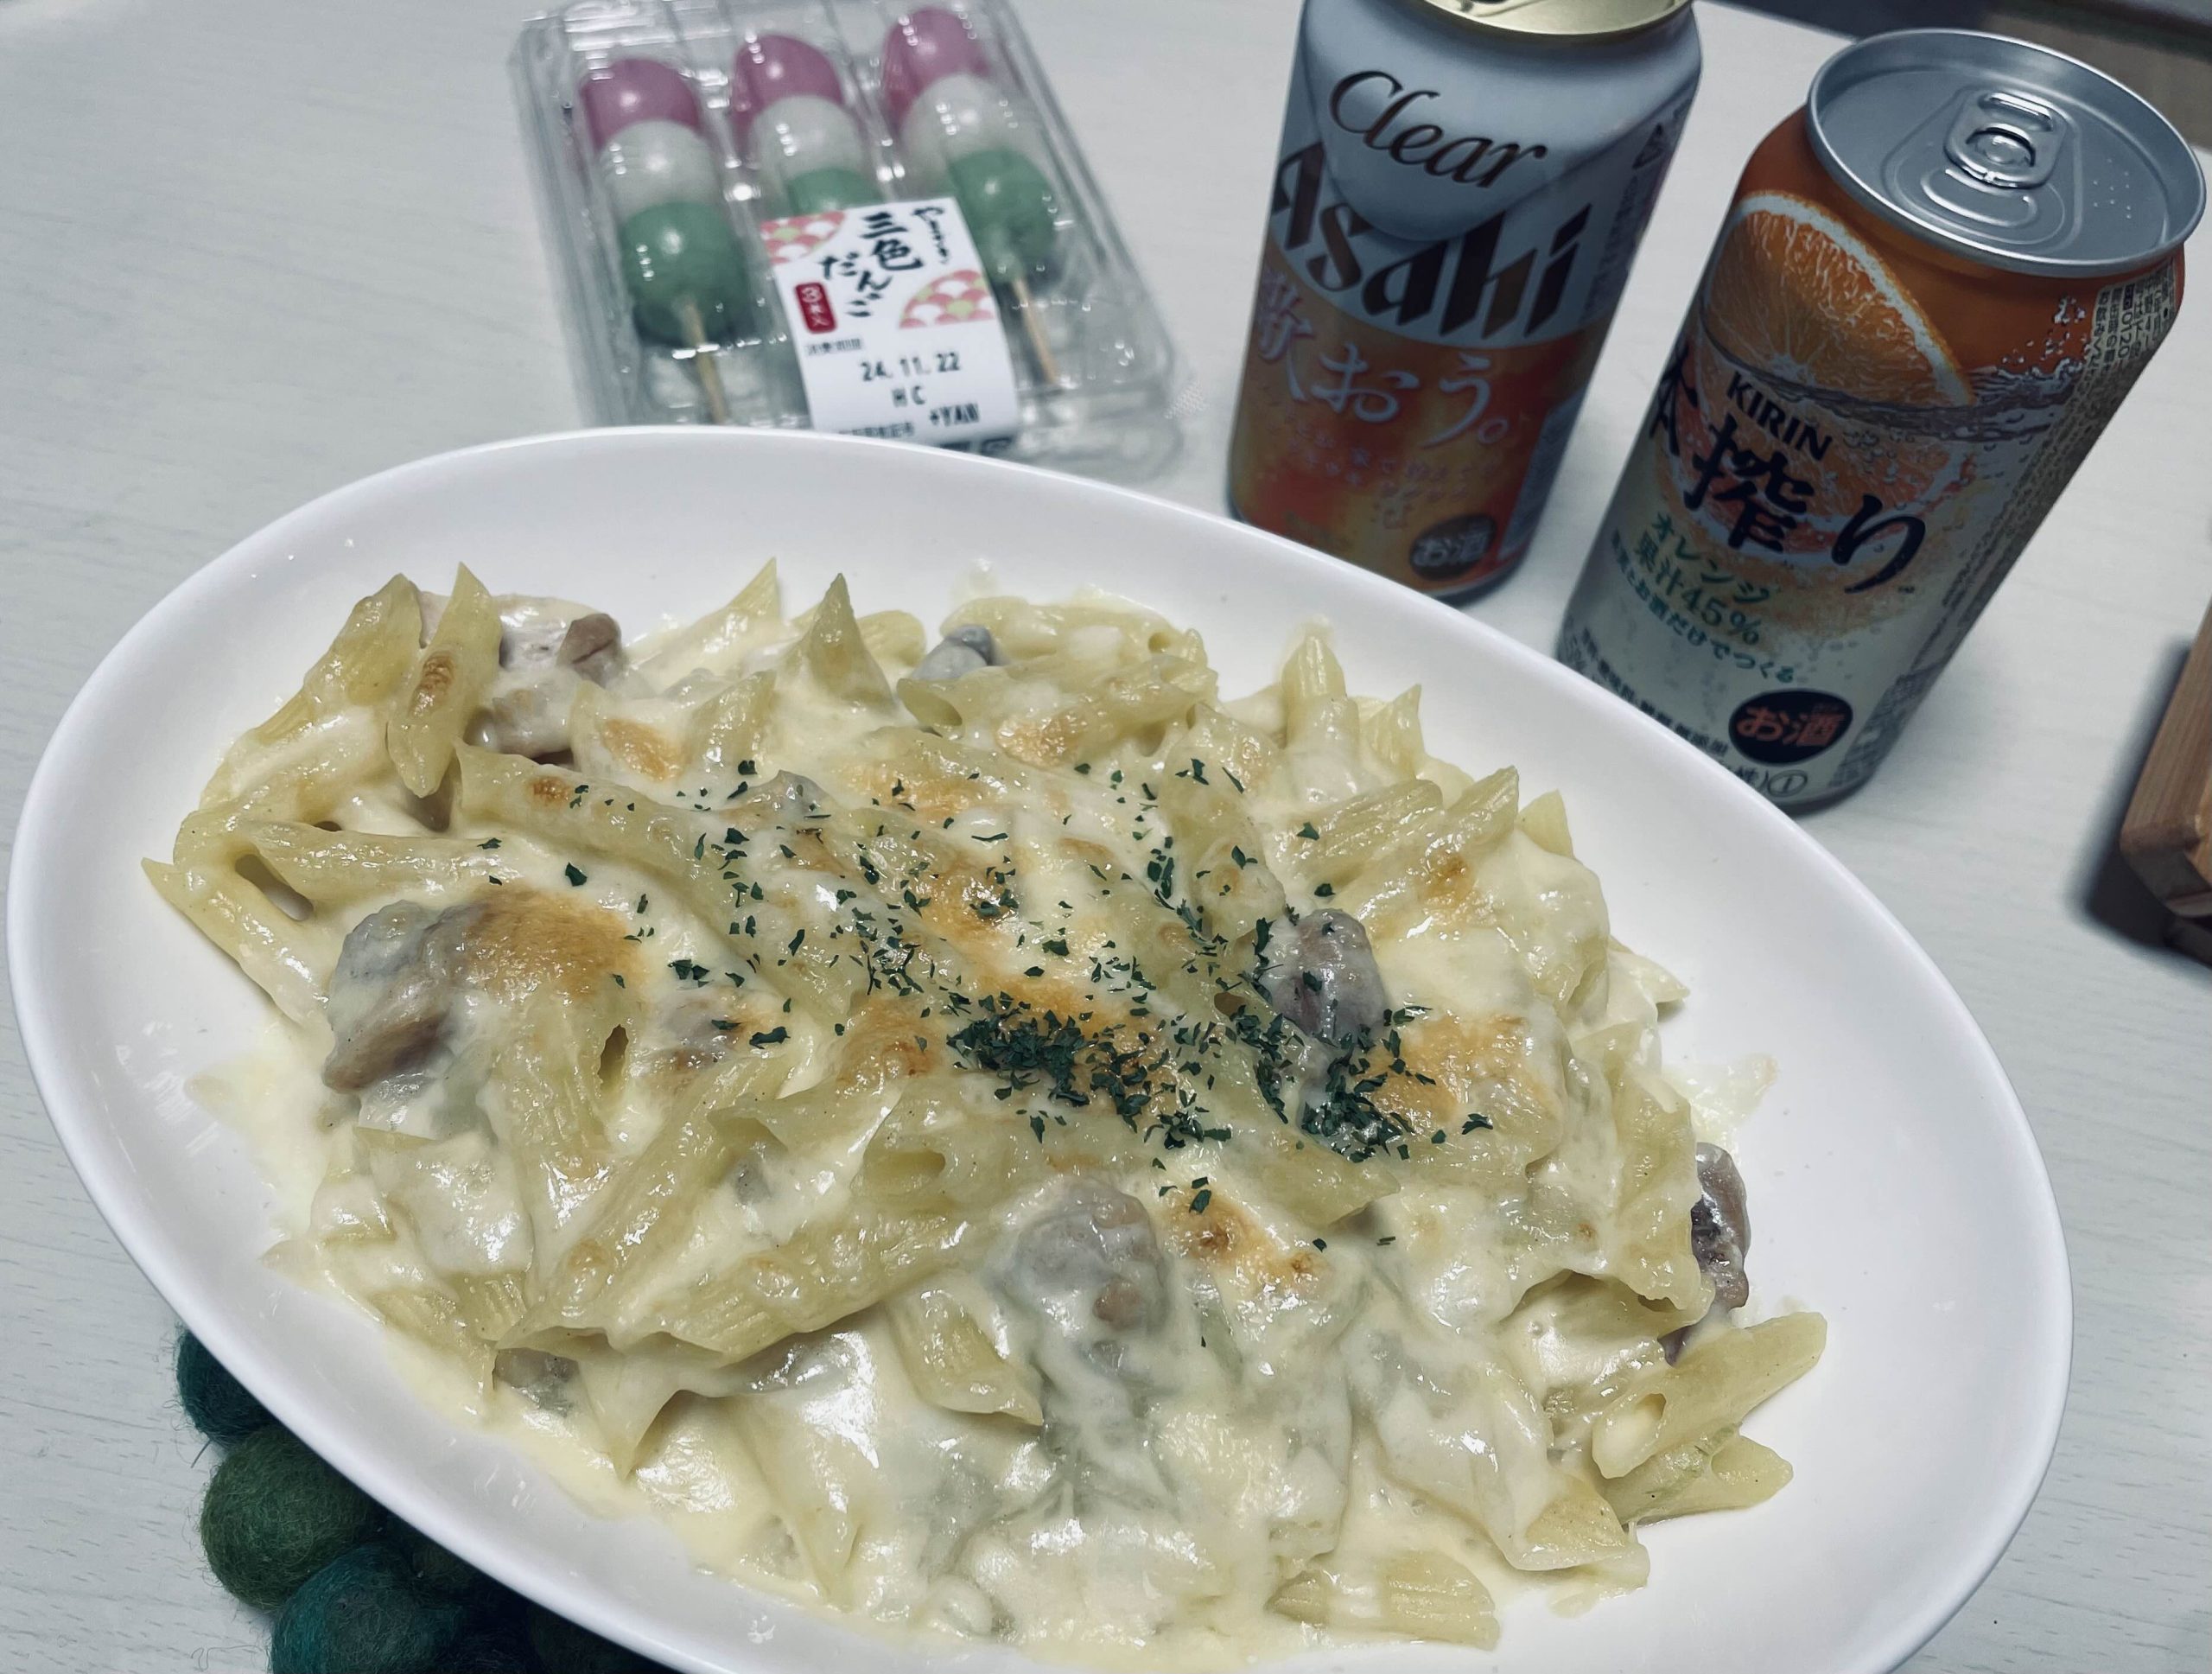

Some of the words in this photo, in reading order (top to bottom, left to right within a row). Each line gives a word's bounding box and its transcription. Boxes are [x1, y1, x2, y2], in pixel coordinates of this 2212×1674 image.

[1328, 70, 1548, 189] Clear
[859, 211, 924, 271] 三色
[1270, 142, 1593, 339] Asahi
[1726, 370, 1834, 461] KIRIN
[1633, 530, 1762, 646] 果汁45%
[1651, 512, 1770, 603] オレンジ
[1735, 705, 1846, 747] お酒
